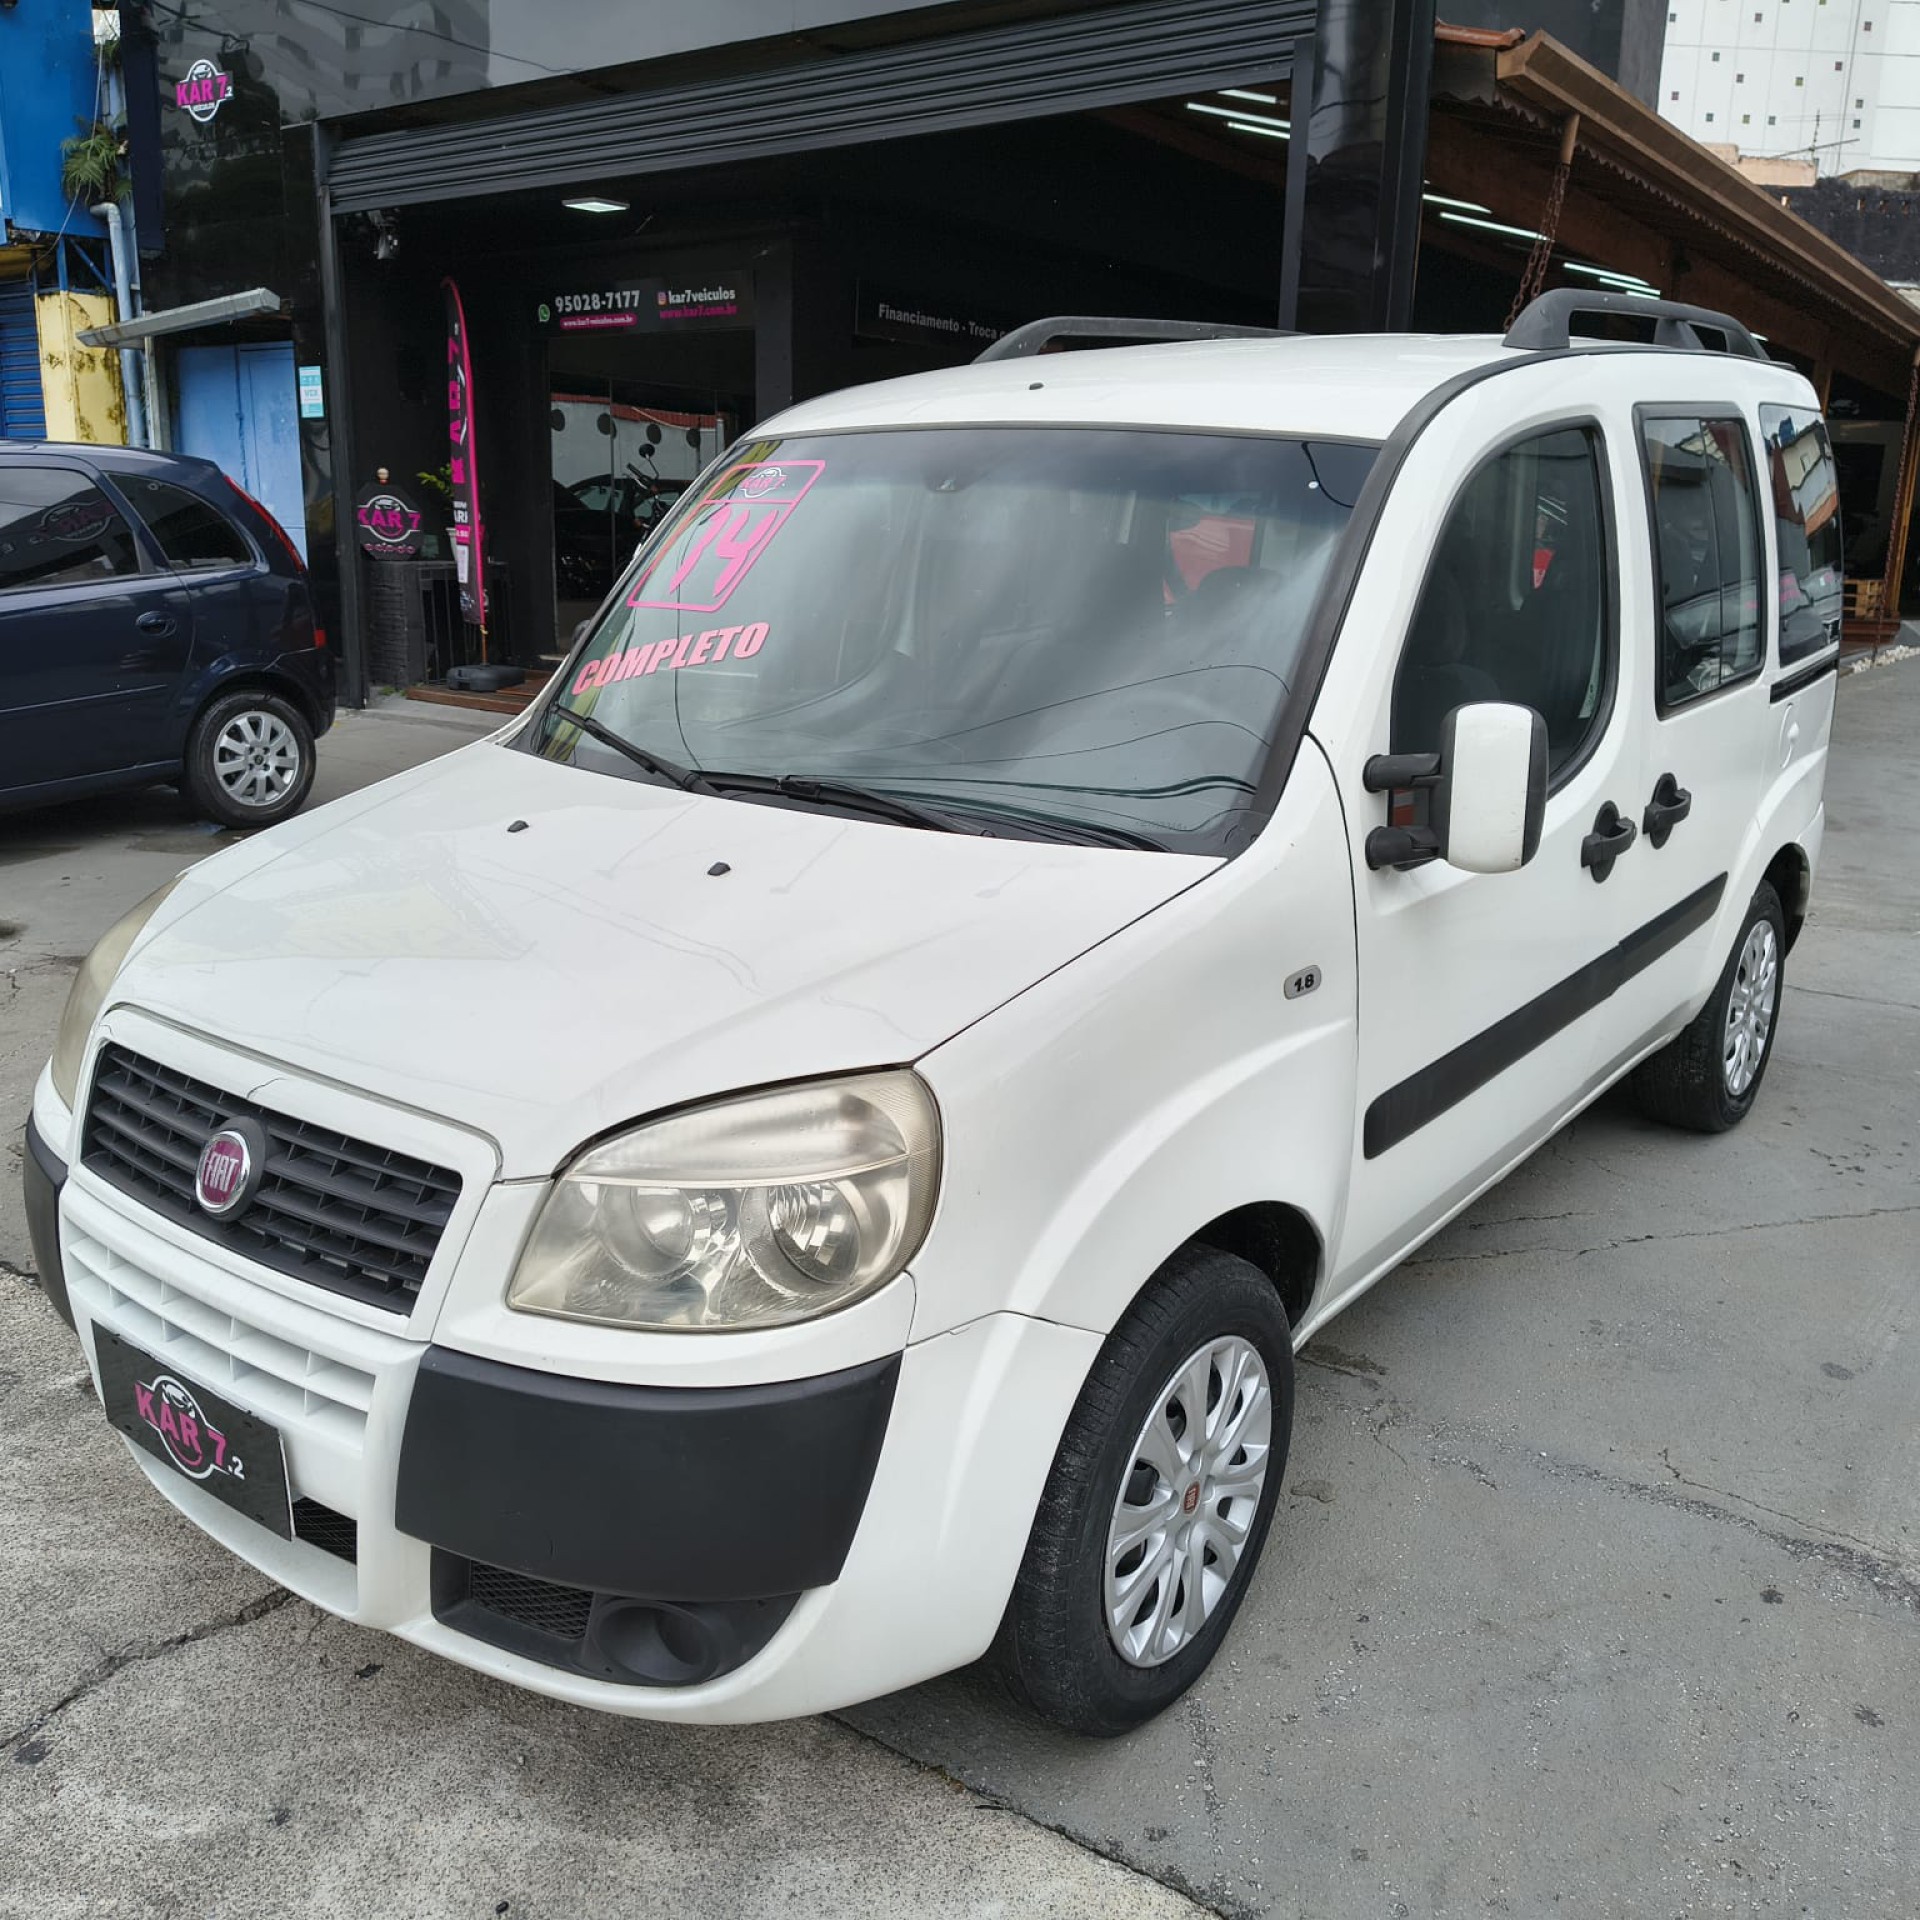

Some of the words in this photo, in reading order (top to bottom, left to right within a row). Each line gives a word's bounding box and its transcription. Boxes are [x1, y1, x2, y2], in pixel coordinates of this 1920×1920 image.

[176, 79, 214, 106] KAR
[555, 290, 640, 313] 95028-7177
[668, 286, 736, 304] kar7veiculos
[879, 303, 960, 332] Financiamento
[968, 321, 997, 340] Troca
[408, 512, 421, 531] 7
[670, 504, 779, 597] 14
[571, 622, 770, 696] COMPLETO
[1295, 973, 1315, 992] 1.8
[204, 1149, 239, 1192] FIAT
[134, 1383, 203, 1456] KAR
